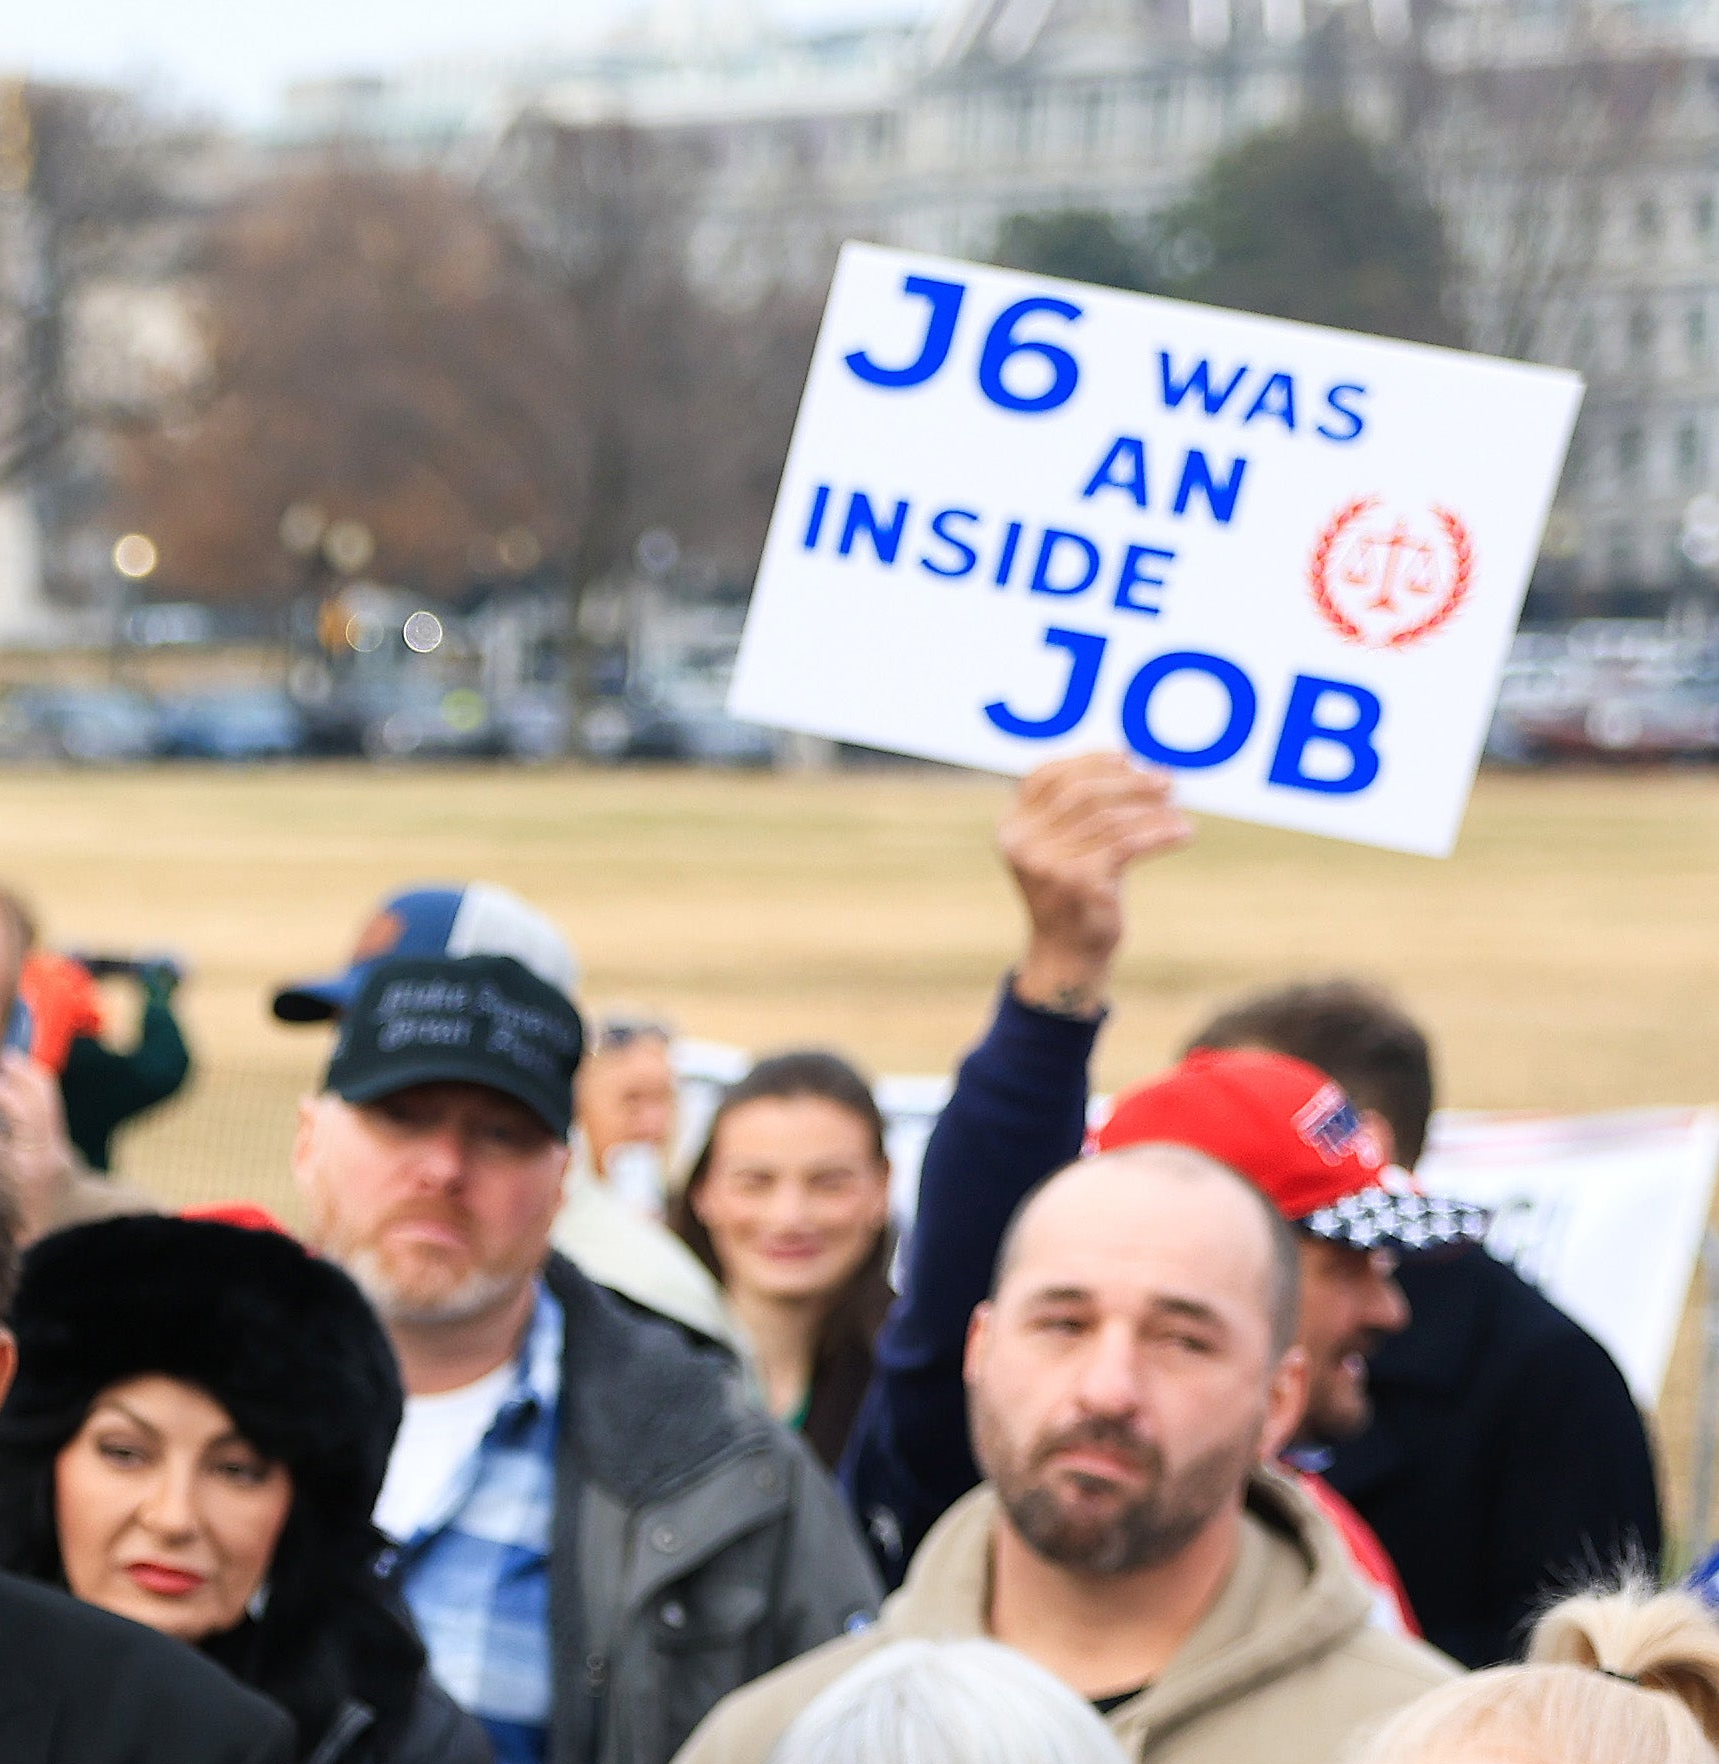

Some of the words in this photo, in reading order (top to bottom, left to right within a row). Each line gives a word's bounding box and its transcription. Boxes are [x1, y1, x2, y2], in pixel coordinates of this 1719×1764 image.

[843, 274, 1084, 413] J6
[1155, 350, 1373, 441] WAS
[802, 484, 1177, 616] INSIDE
[1081, 436, 1247, 524] AN
[984, 627, 1382, 795] JOB
